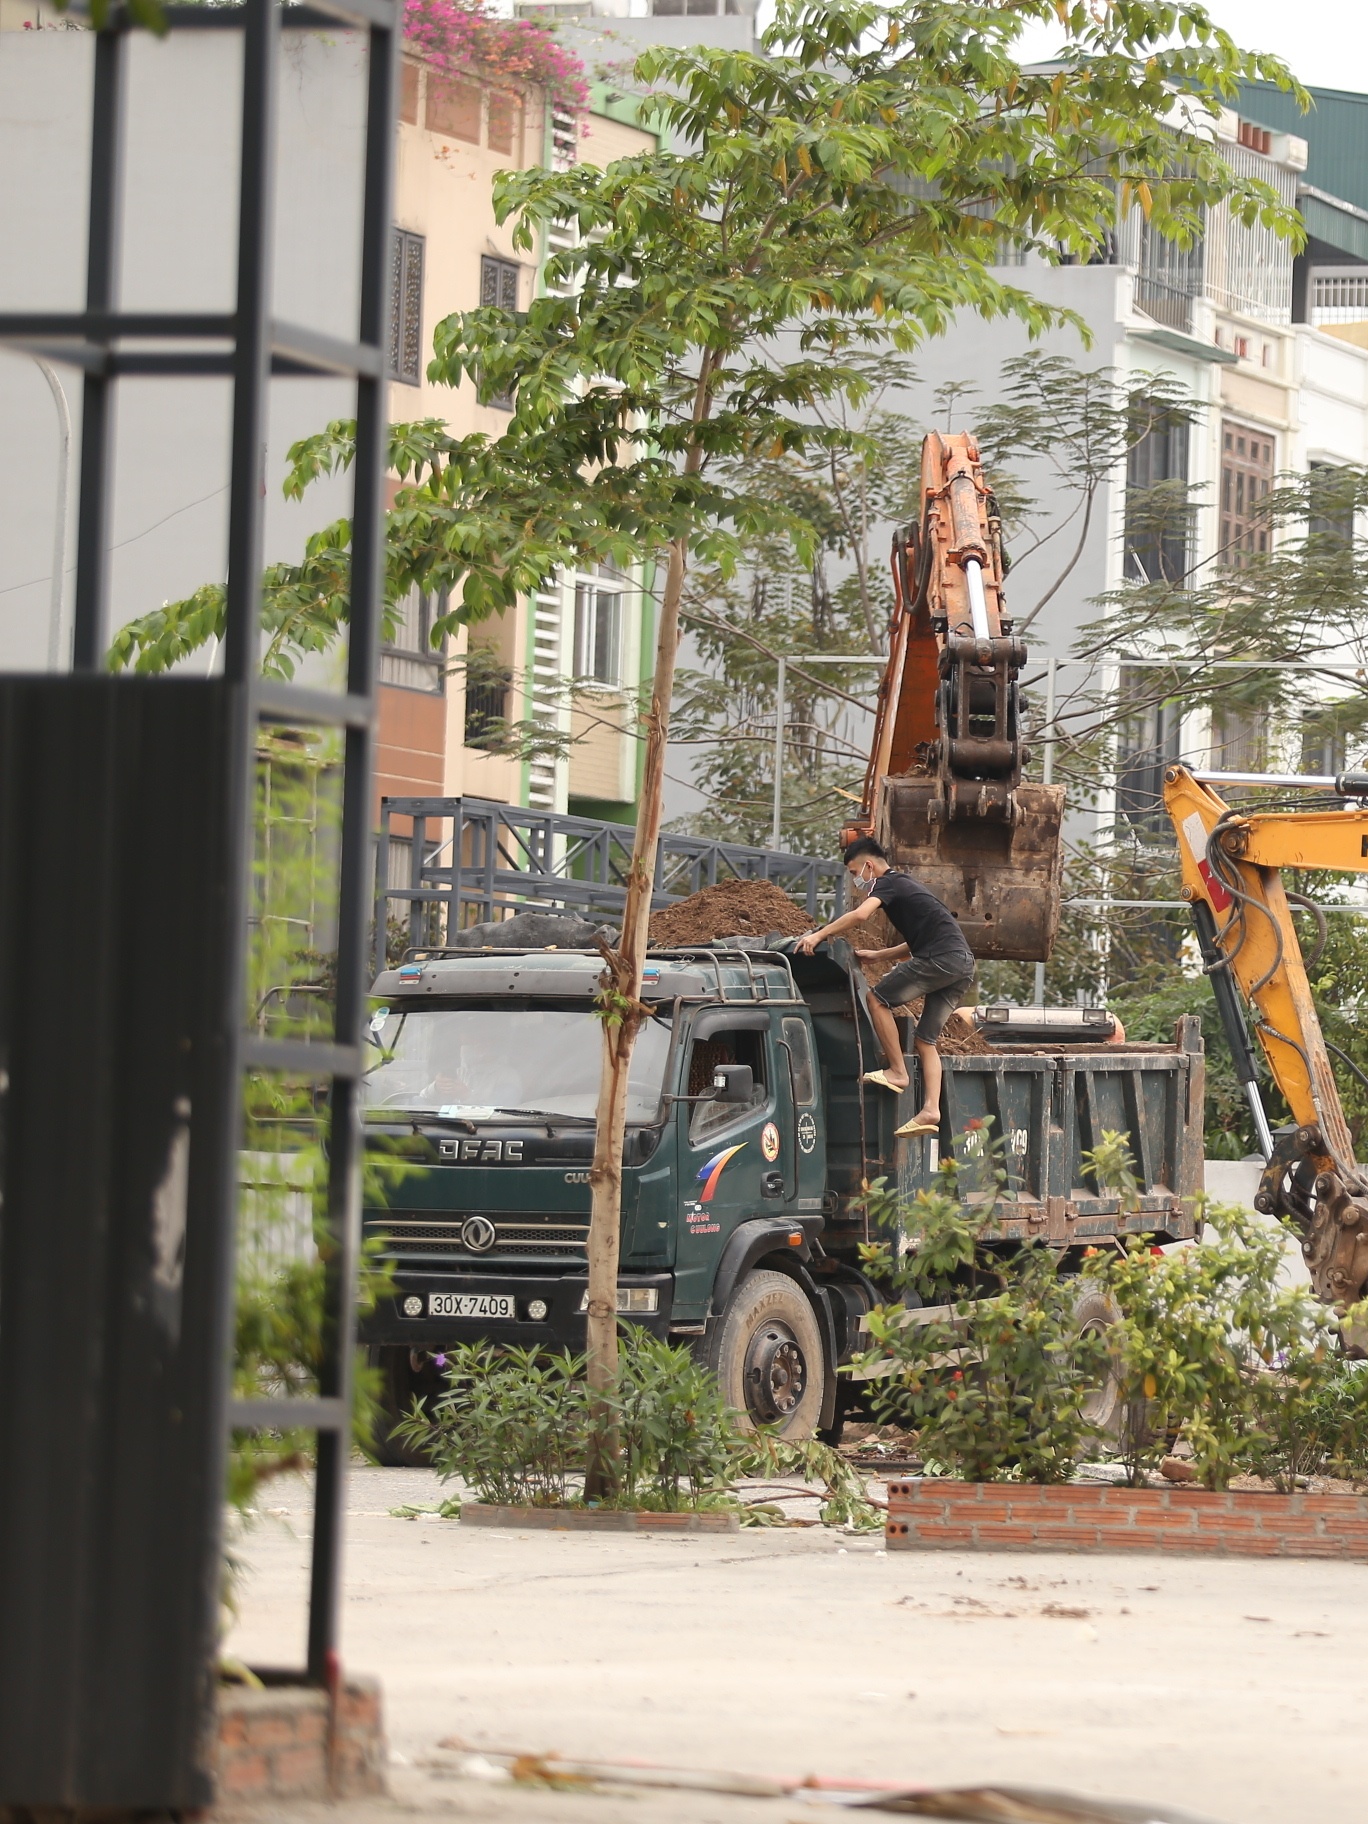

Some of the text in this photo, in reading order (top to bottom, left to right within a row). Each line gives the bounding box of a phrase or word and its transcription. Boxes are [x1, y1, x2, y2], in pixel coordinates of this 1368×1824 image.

[439, 1139, 524, 1161] DFAC
[564, 1172, 591, 1184] CUU
[434, 1296, 509, 1316] 30X-7409
